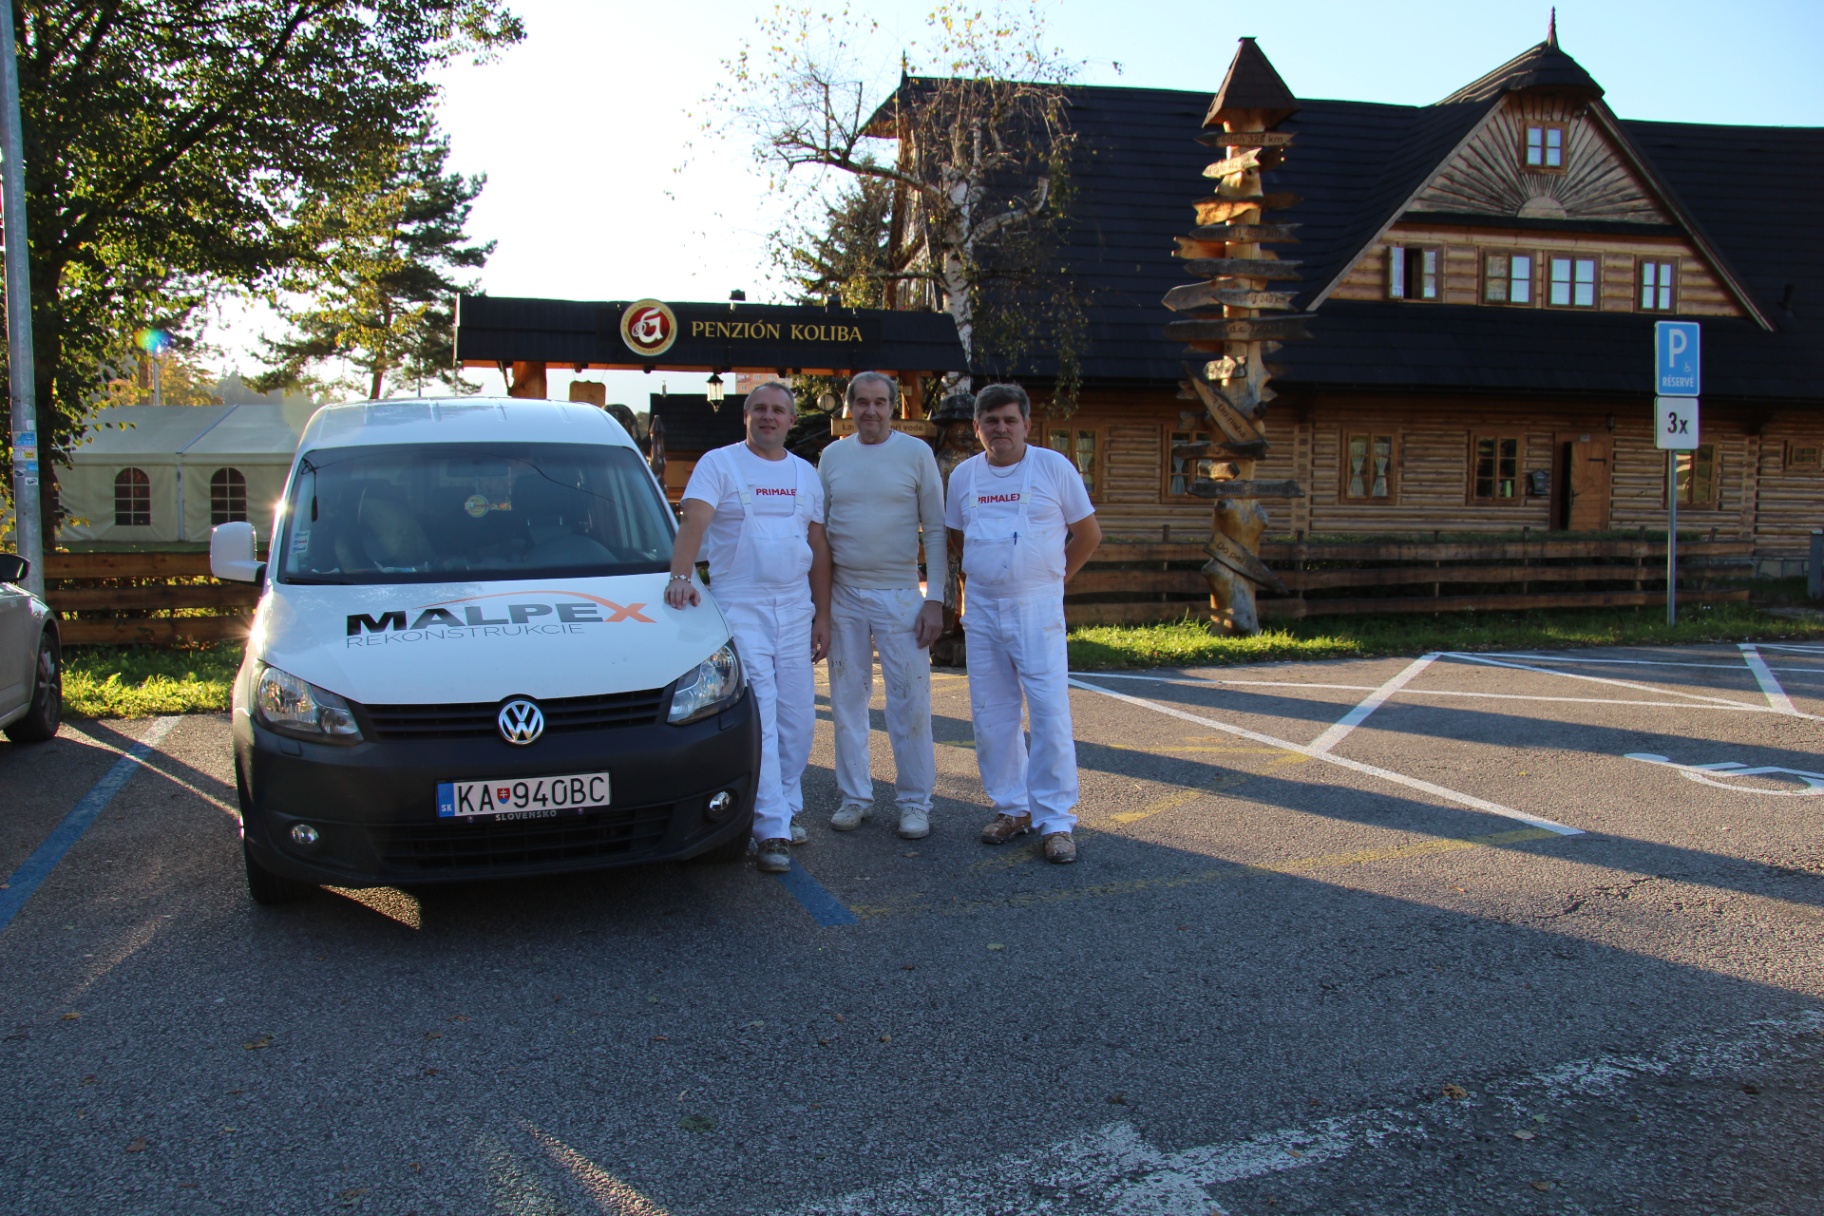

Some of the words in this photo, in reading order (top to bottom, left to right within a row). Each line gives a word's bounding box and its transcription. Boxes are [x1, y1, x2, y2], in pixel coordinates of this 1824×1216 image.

[1268, 133, 1283, 143] km
[691, 319, 780, 340] PENZIÓN
[790, 324, 863, 342] KOLIBA
[1668, 328, 1687, 368] P
[1662, 375, 1694, 388] RÉSERVÉ
[903, 423, 923, 431] vode
[1667, 411, 1688, 434] 3x
[755, 488, 797, 496] PRIMALE
[1216, 541, 1228, 554] Do
[346, 602, 657, 636] MALPEX
[346, 623, 585, 649] REKONSTRUKCIE
[495, 809, 557, 822] SLOVENSKO
